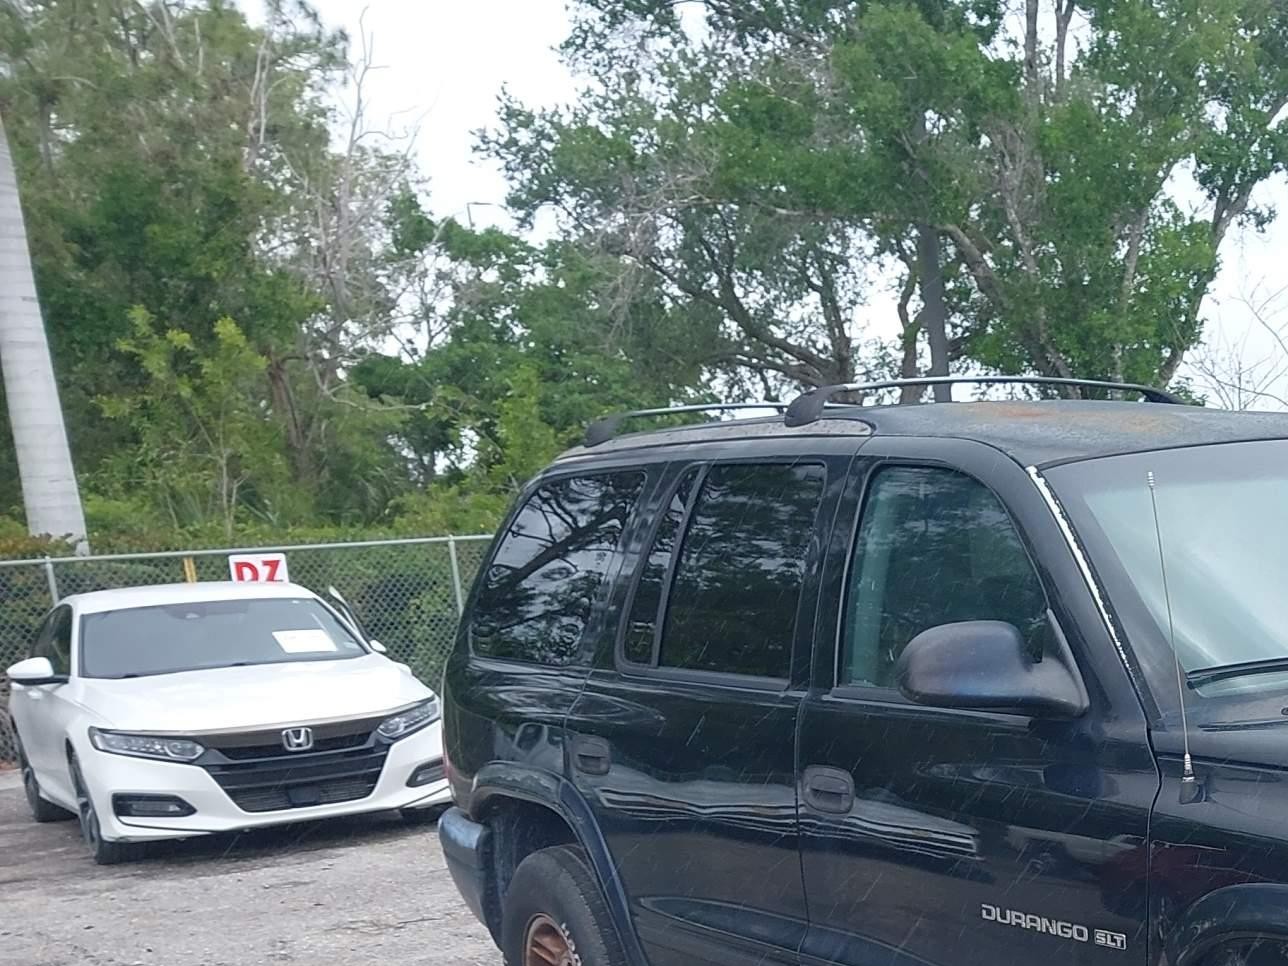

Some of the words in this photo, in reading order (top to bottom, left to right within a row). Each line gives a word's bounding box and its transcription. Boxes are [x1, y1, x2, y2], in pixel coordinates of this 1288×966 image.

[234, 559, 284, 582] DZ
[981, 903, 1089, 942] DURANGO
[1094, 931, 1125, 949] SLT
